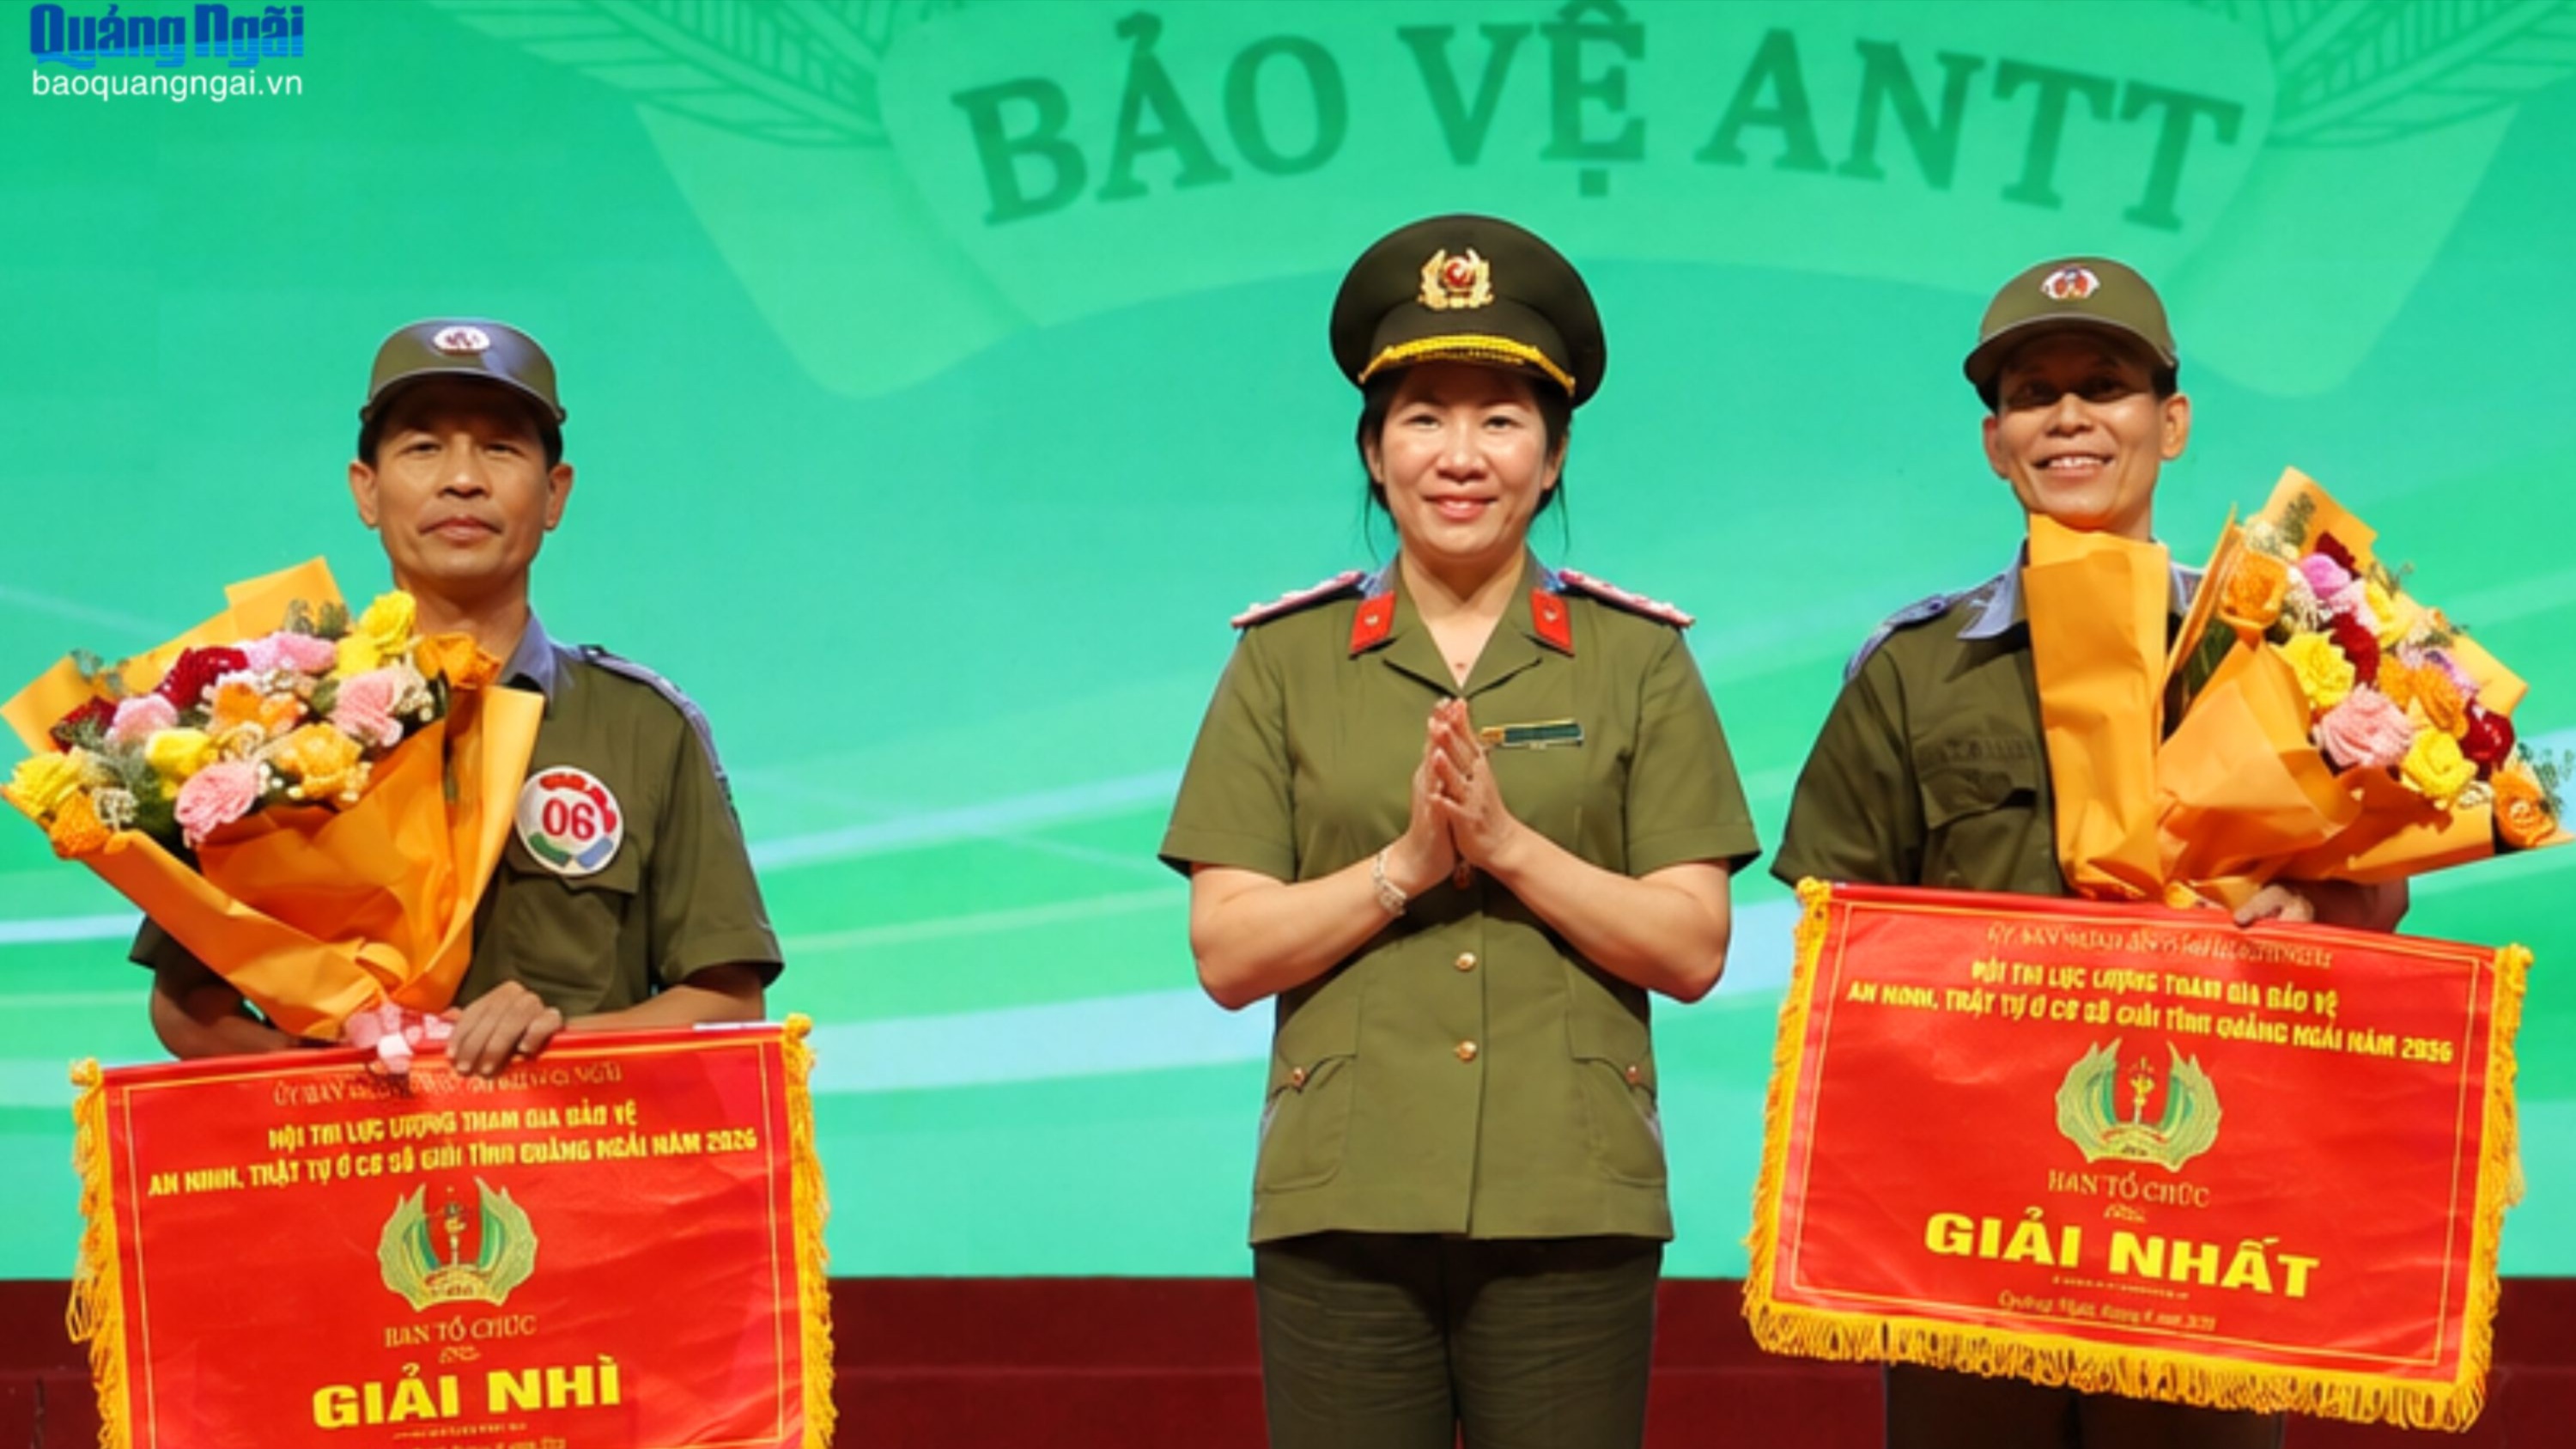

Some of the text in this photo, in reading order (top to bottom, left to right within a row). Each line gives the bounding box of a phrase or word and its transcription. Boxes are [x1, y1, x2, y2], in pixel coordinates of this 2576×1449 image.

[951, 0, 2245, 234] BẢO VỆ ANTT
[543, 797, 595, 841] 06
[1924, 1206, 2320, 1298] GIẢI NHẤT
[313, 1354, 621, 1429] GIẢI NHÌ
